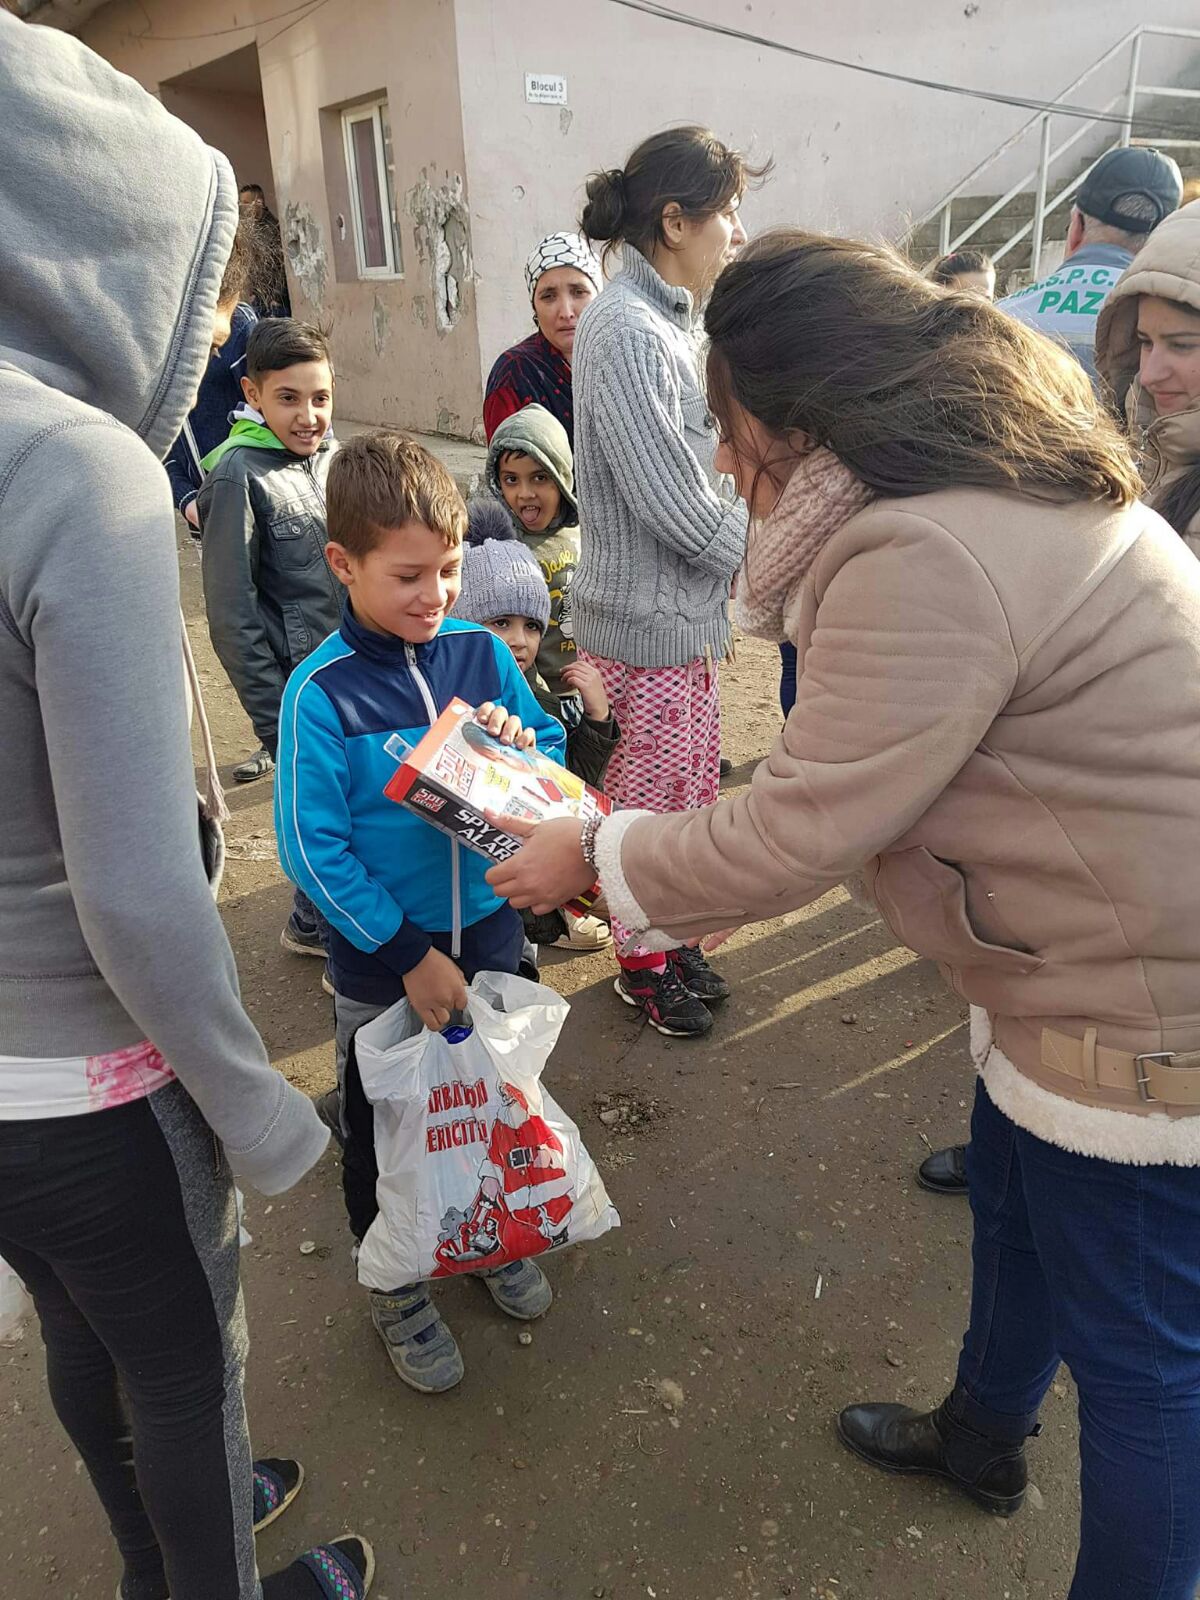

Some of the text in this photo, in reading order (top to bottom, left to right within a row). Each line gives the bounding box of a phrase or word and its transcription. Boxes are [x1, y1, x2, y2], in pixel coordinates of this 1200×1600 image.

[531, 80, 564, 93] Blocul 3
[1038, 291, 1105, 315] PAZ
[454, 808, 497, 834] SPY
